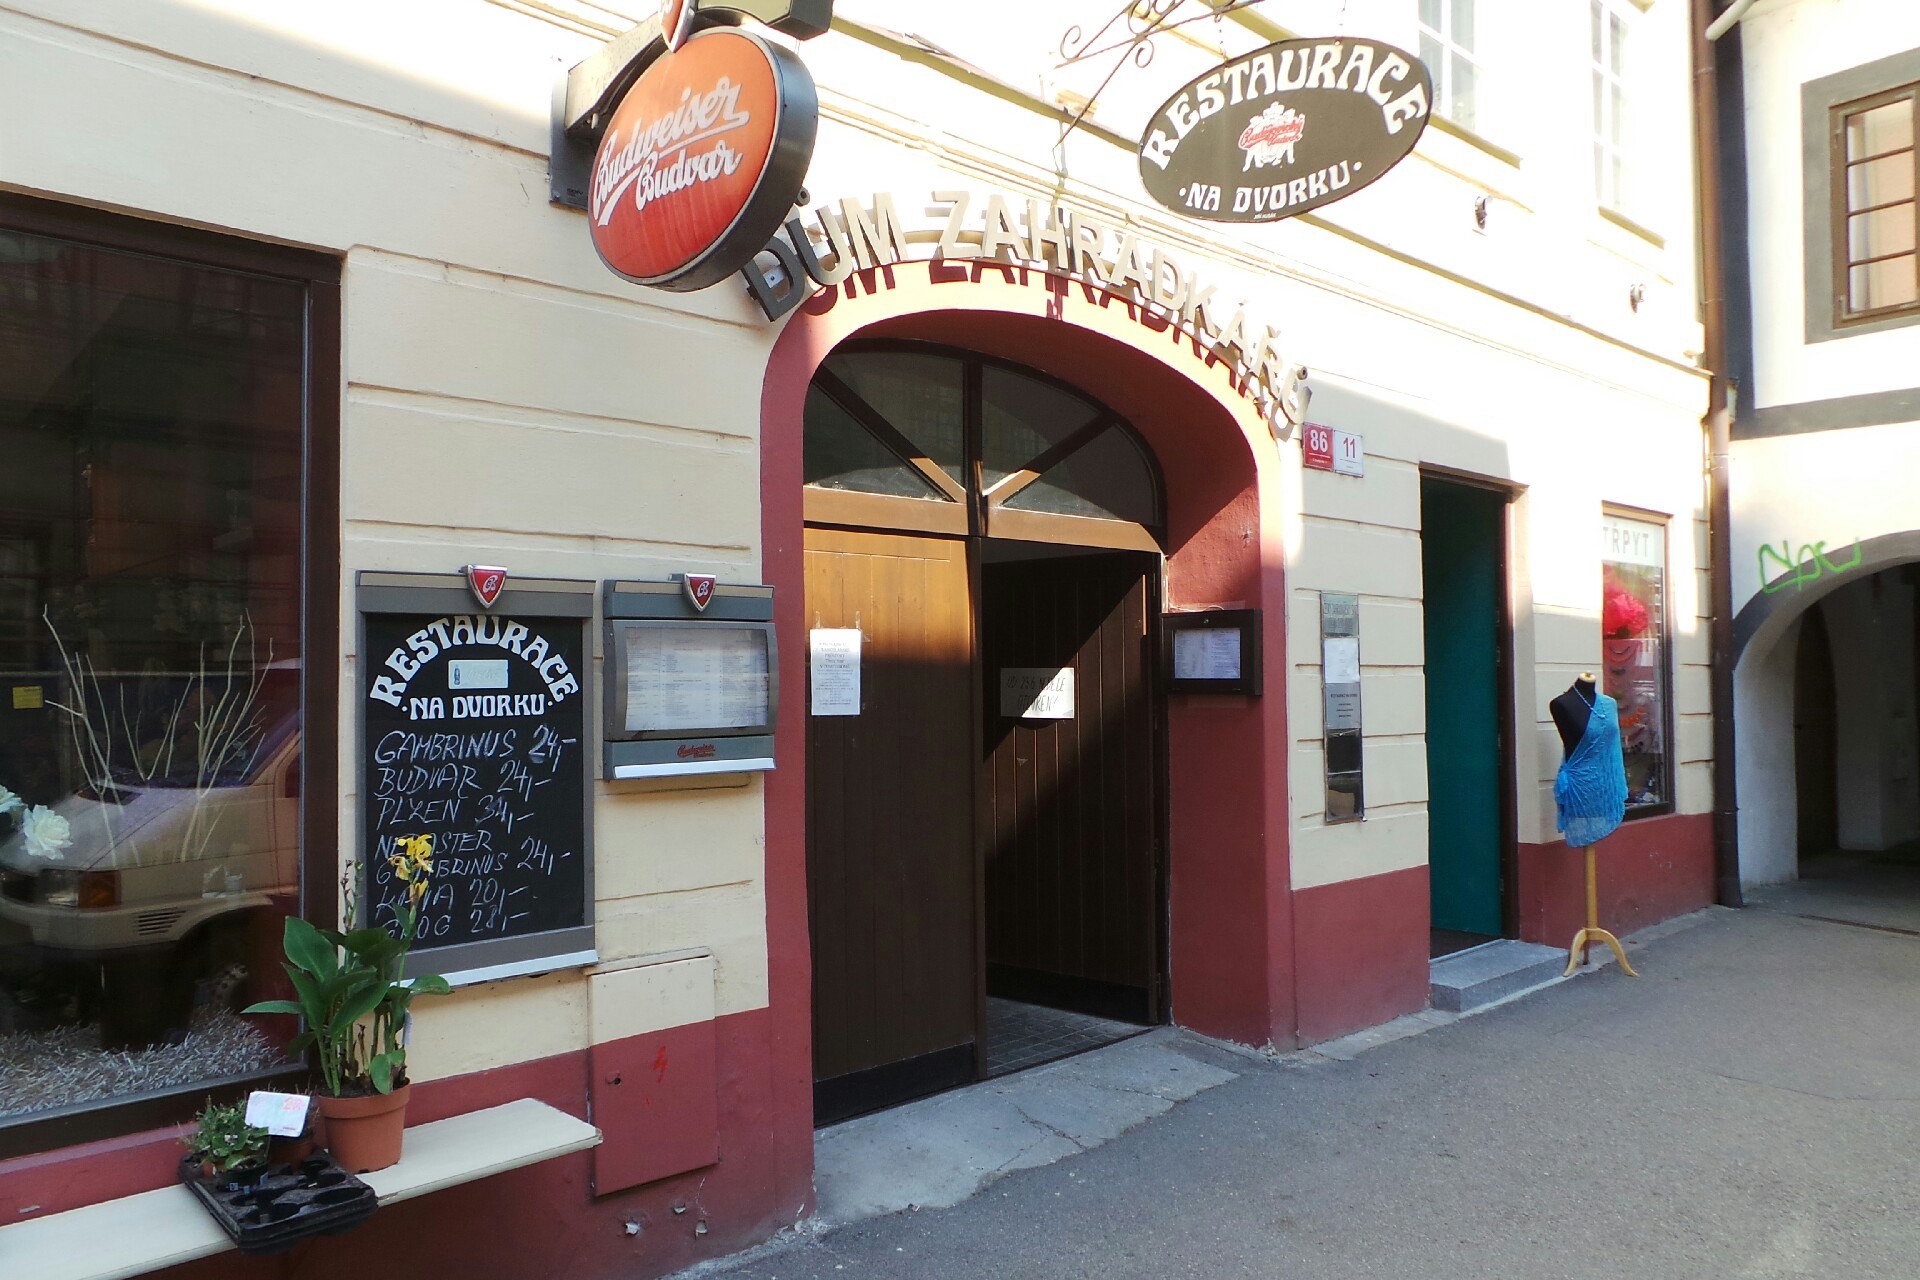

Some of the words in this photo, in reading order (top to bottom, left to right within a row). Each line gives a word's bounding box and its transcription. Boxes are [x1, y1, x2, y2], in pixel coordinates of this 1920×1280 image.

[1141, 44, 1428, 170] RESTAURACE
[593, 76, 749, 226] Budweiser
[636, 140, 743, 210] Budvar
[1185, 182, 1221, 211] NA
[1232, 159, 1351, 212] DVORKU
[1310, 429, 1328, 453] 86
[1343, 437, 1356, 458] 11
[370, 615, 579, 707] RESTAURACE
[410, 697, 445, 720] NA
[453, 694, 545, 718] DVORKU
[374, 728, 517, 764] GAMBRINUS
[374, 762, 482, 799] BUDVAR
[376, 852, 509, 885] GBRINUS
[381, 914, 452, 940] GOG
